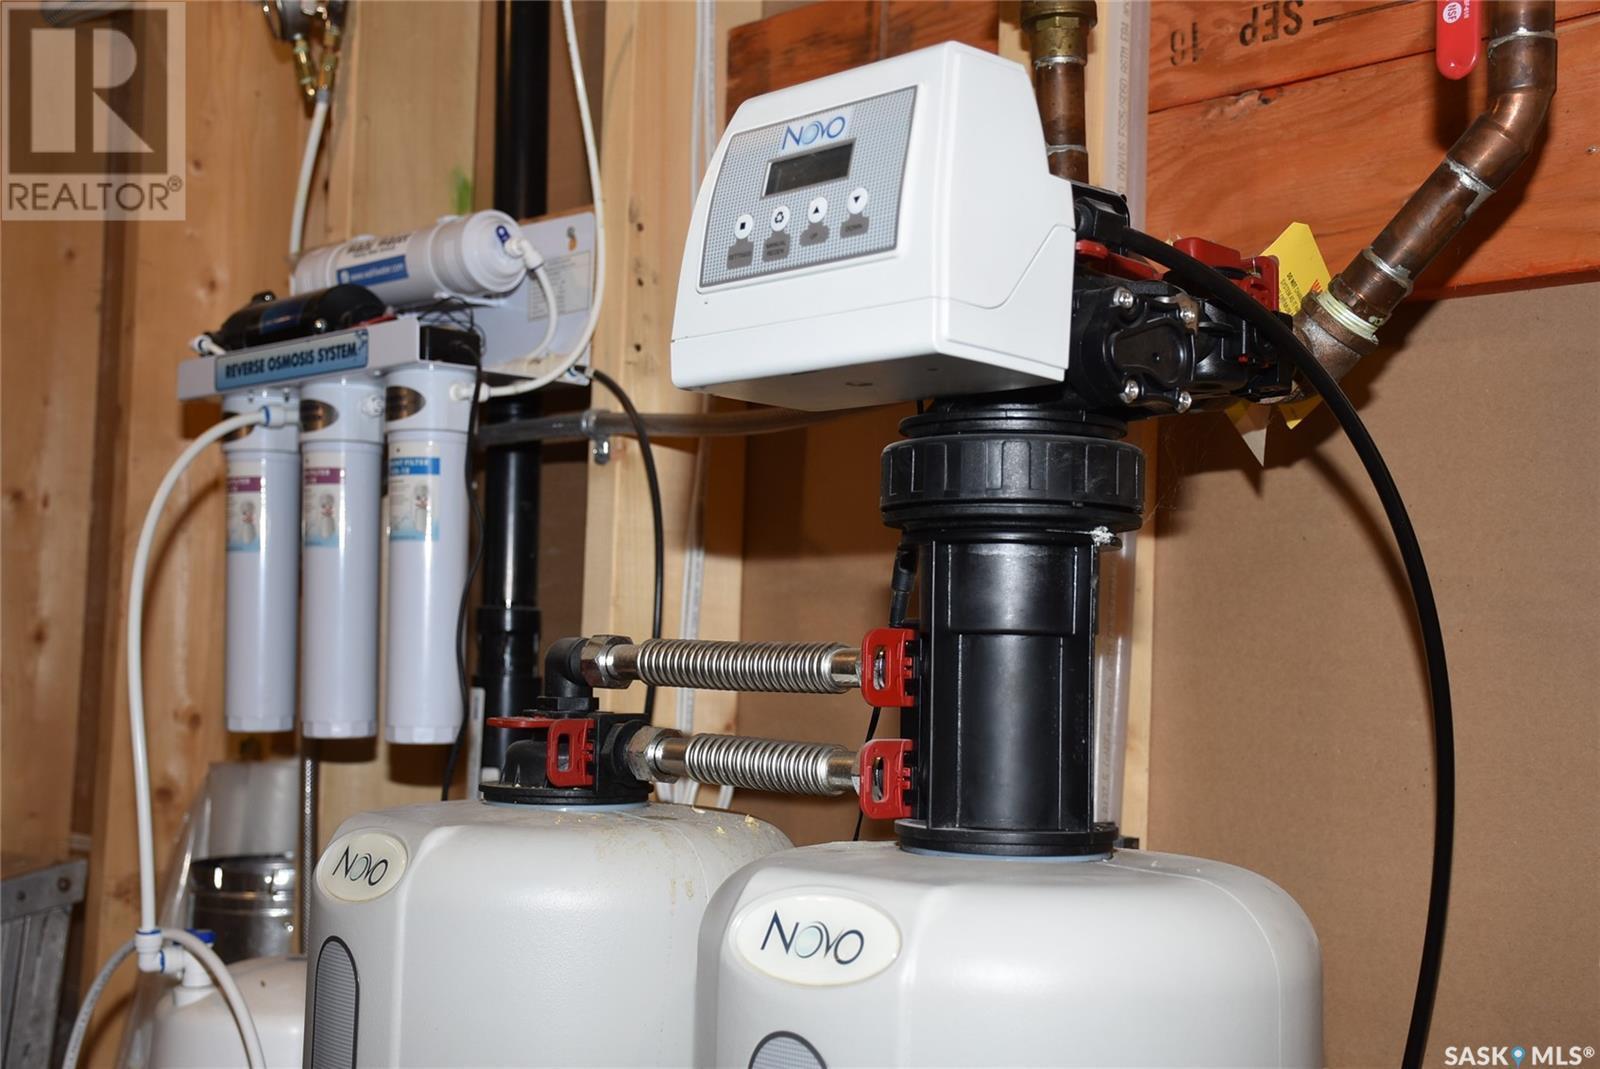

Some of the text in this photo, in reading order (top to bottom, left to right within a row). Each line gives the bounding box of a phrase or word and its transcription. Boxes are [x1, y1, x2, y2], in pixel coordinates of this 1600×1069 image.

[1239, 0, 1305, 47] SEP
[225, 341, 358, 379] REVERSE OSMOSIS SYSTEM
